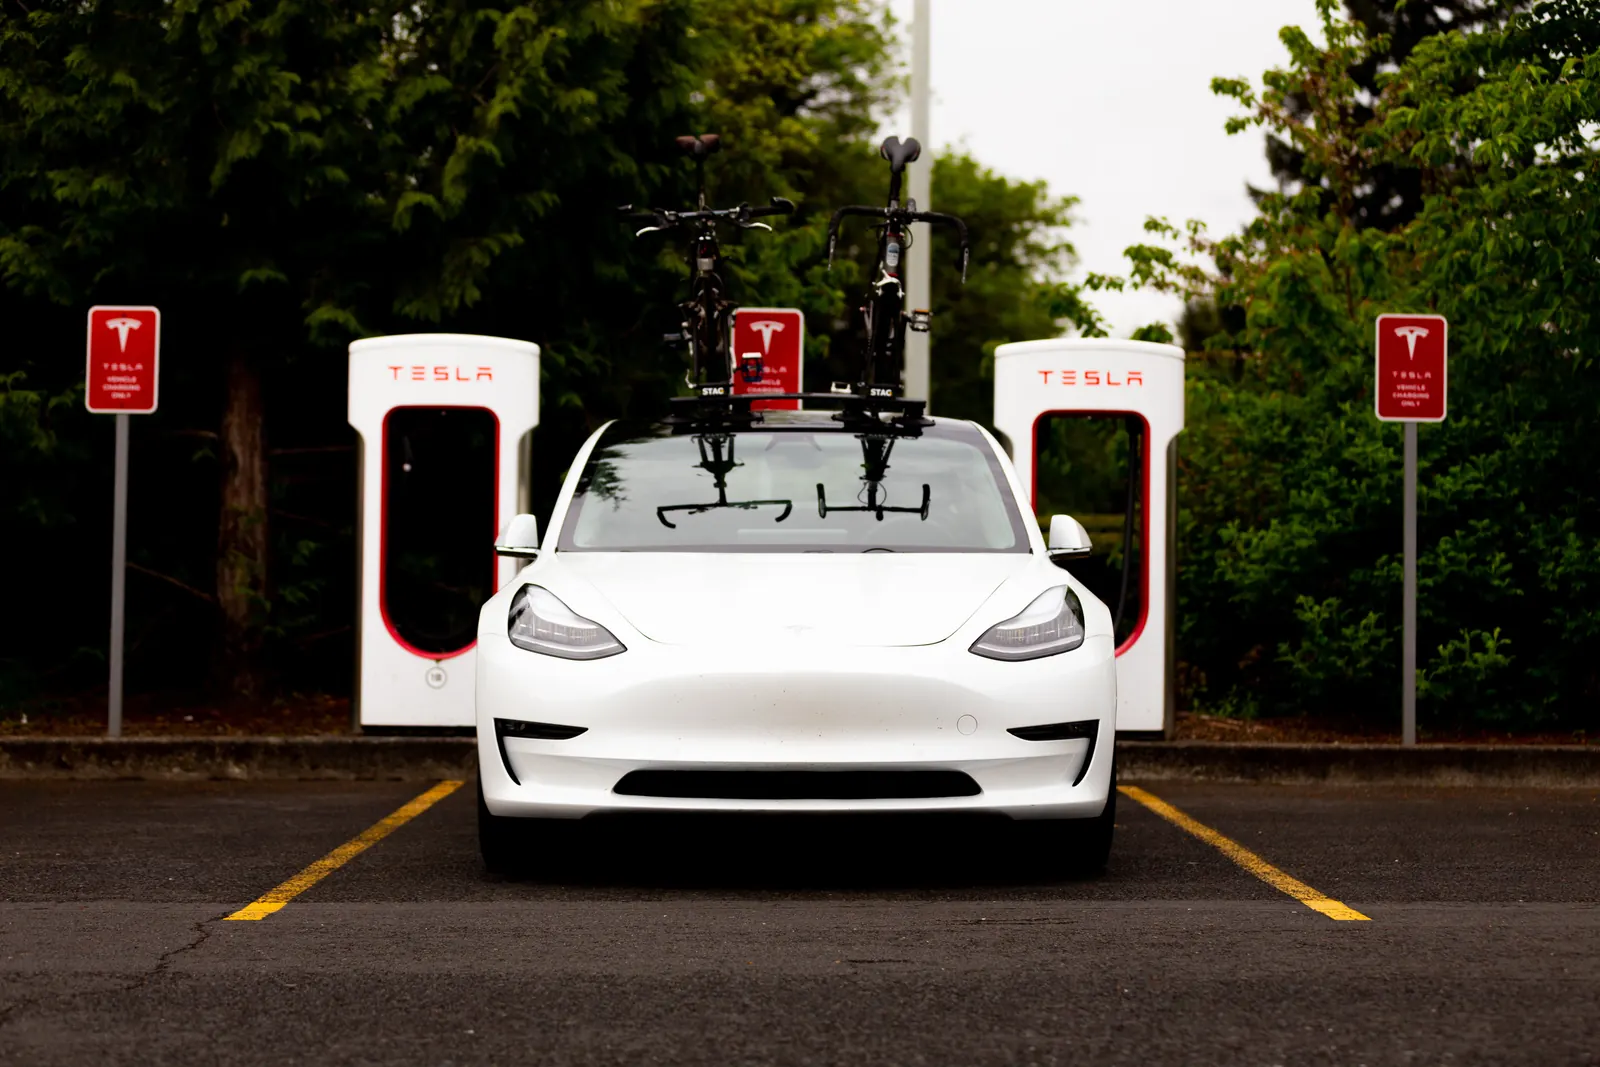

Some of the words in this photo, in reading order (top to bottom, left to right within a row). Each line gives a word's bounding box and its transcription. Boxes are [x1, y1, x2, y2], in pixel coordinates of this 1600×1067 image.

[103, 363, 143, 371] TESLA
[388, 366, 493, 381] TESLA
[1038, 370, 1143, 386] TESLA
[1392, 370, 1432, 379] TESLA
